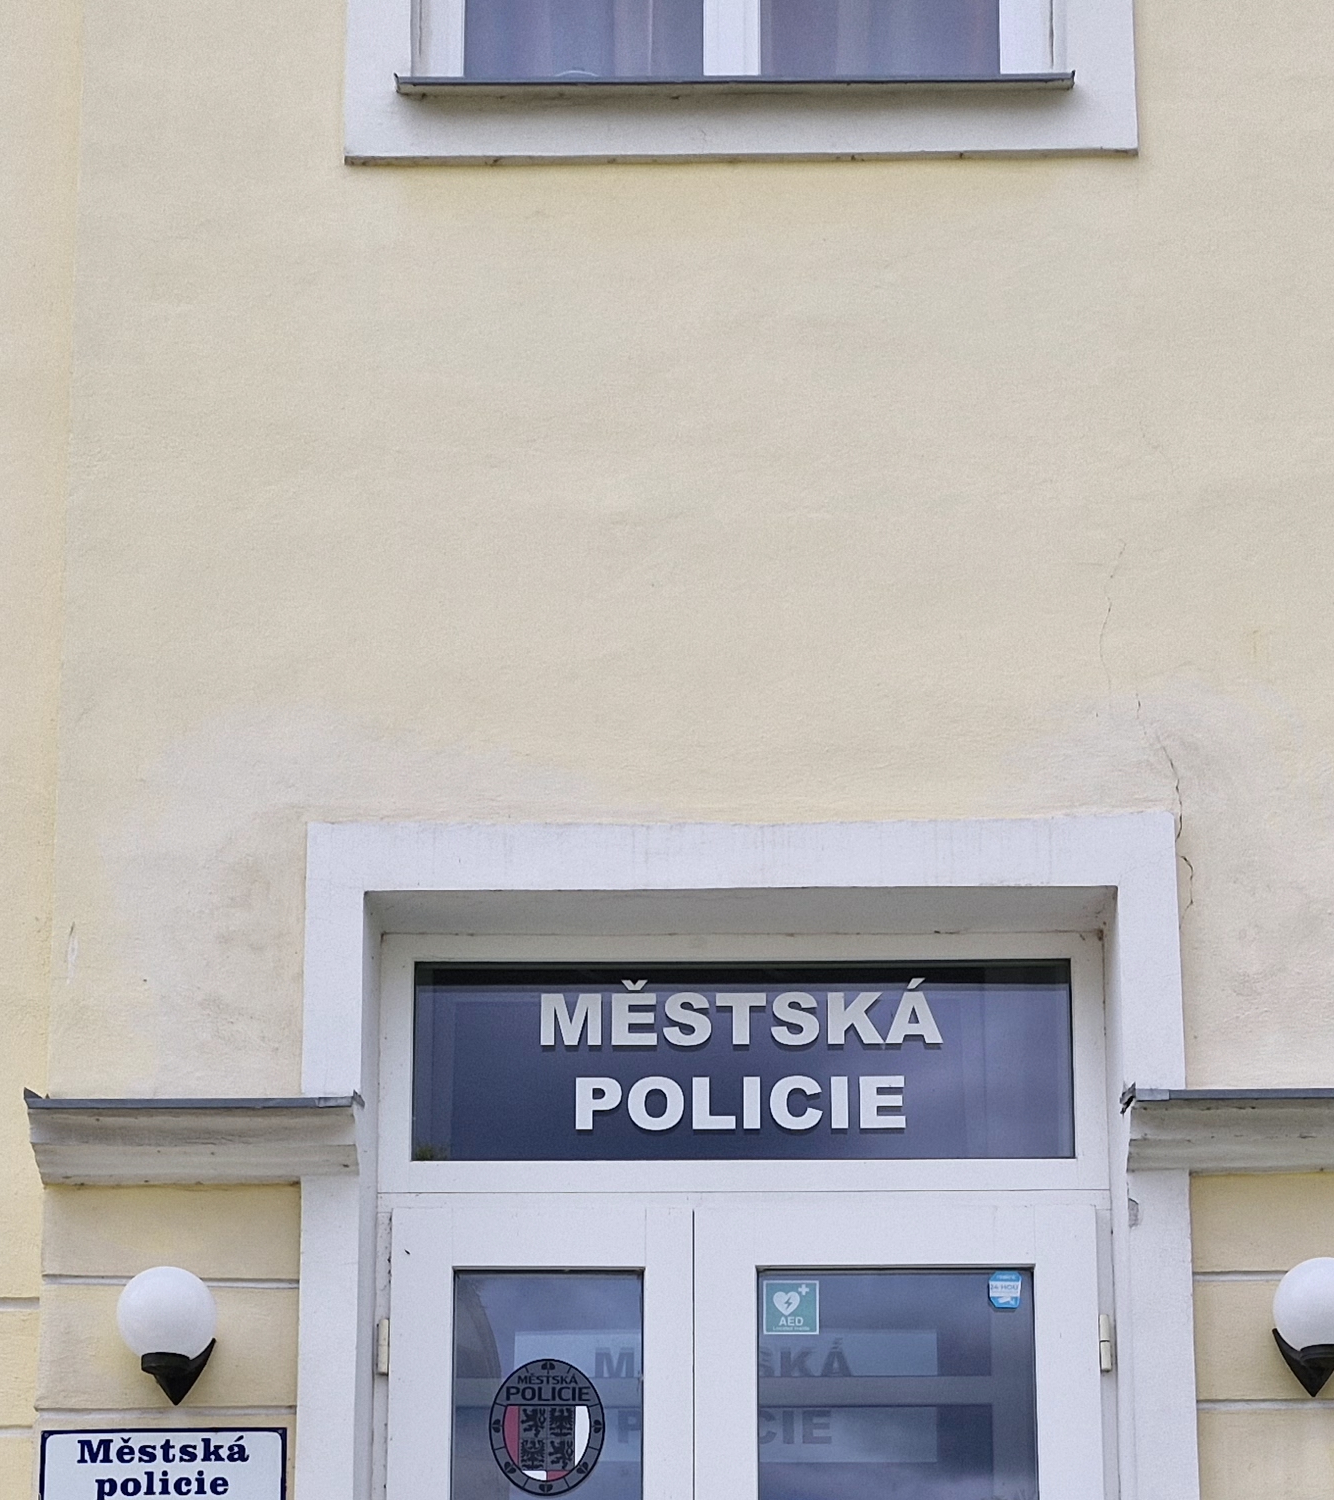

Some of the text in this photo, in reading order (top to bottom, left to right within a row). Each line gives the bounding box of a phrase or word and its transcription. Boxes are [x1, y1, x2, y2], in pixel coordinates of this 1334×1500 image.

[540, 977, 944, 1048] MĚSTSKÁ
[574, 1074, 908, 1132] POLICIE
[778, 1316, 804, 1326] AED
[517, 1373, 579, 1385] MĚSTSKÁ
[505, 1386, 592, 1402] POLICIE
[76, 1434, 250, 1464] Městská
